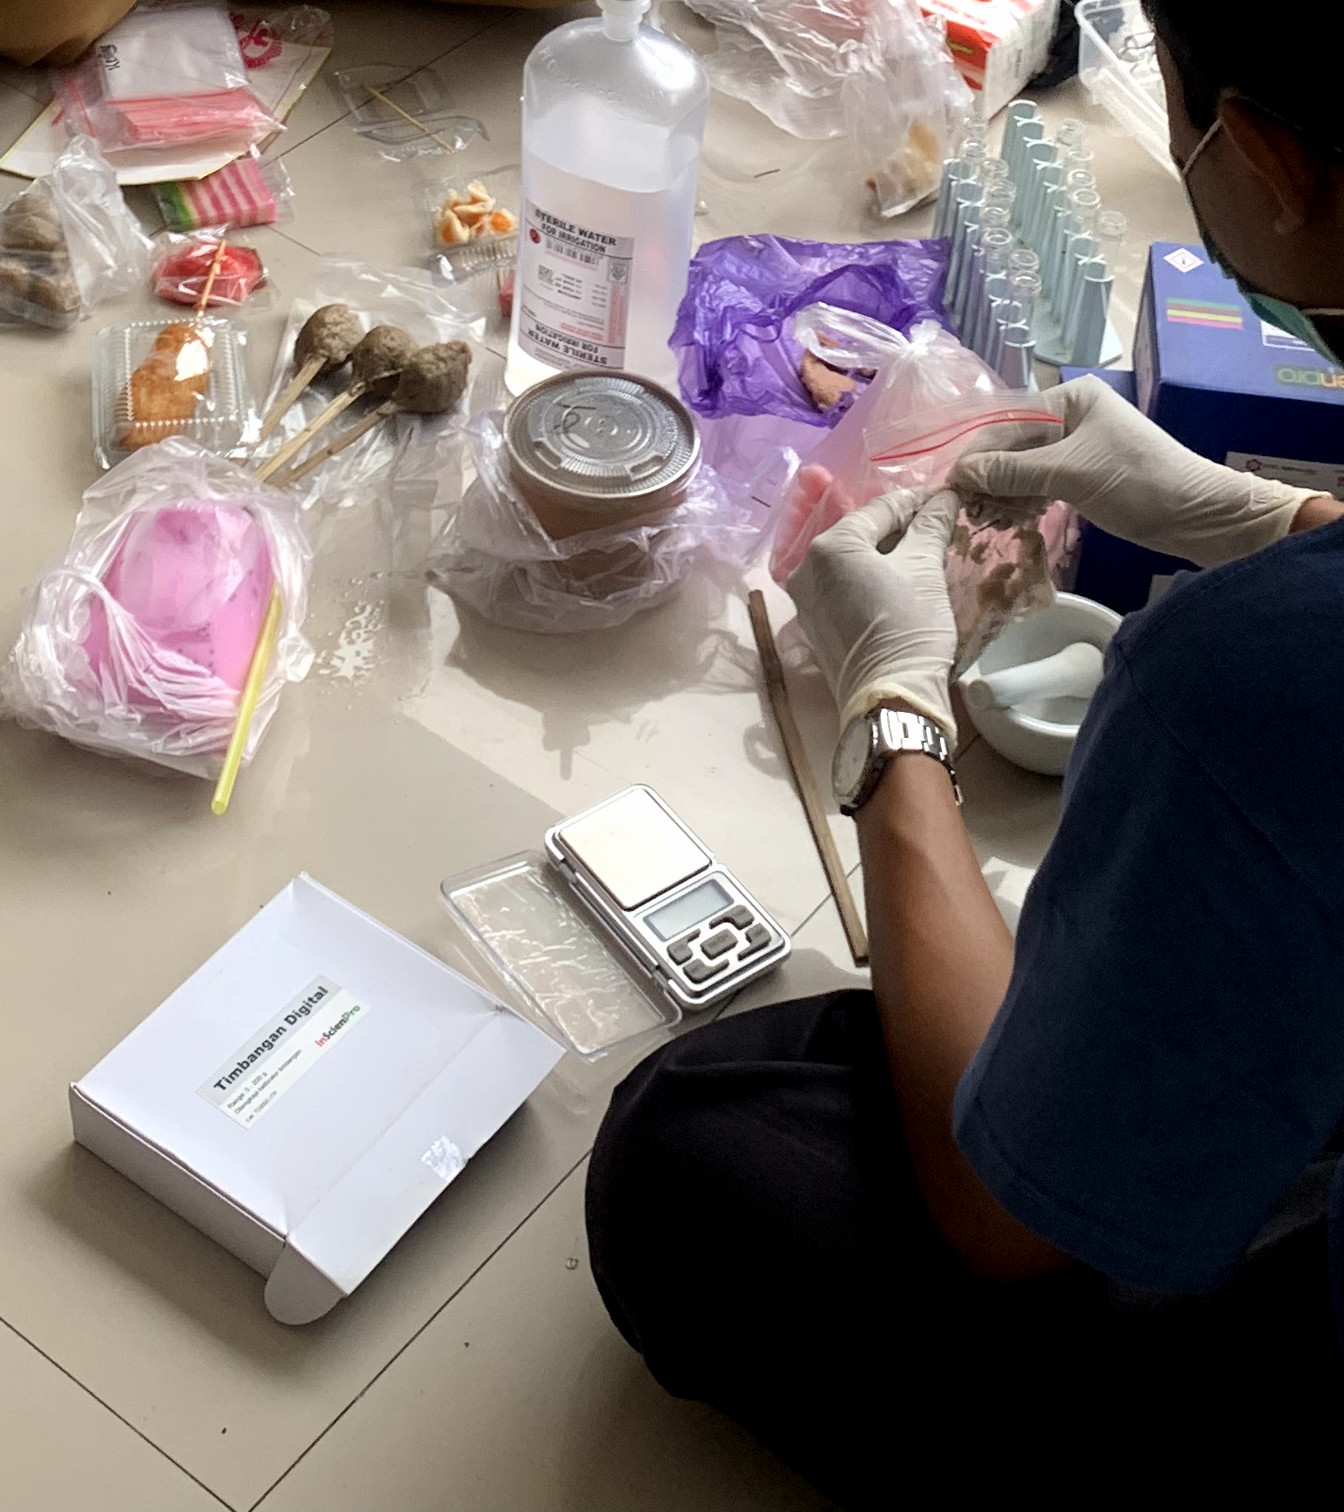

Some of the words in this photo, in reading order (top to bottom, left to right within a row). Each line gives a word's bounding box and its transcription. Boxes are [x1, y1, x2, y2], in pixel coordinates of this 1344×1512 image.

[535, 208, 575, 233] STERILE
[579, 228, 616, 246] WATER
[542, 223, 557, 236] FOR
[559, 230, 606, 253] IRRIGATION
[563, 345, 607, 364] STERILE
[213, 1026, 287, 1091] Timbangan
[283, 986, 328, 1026] Digital
[315, 1005, 360, 1047] InScienPro
